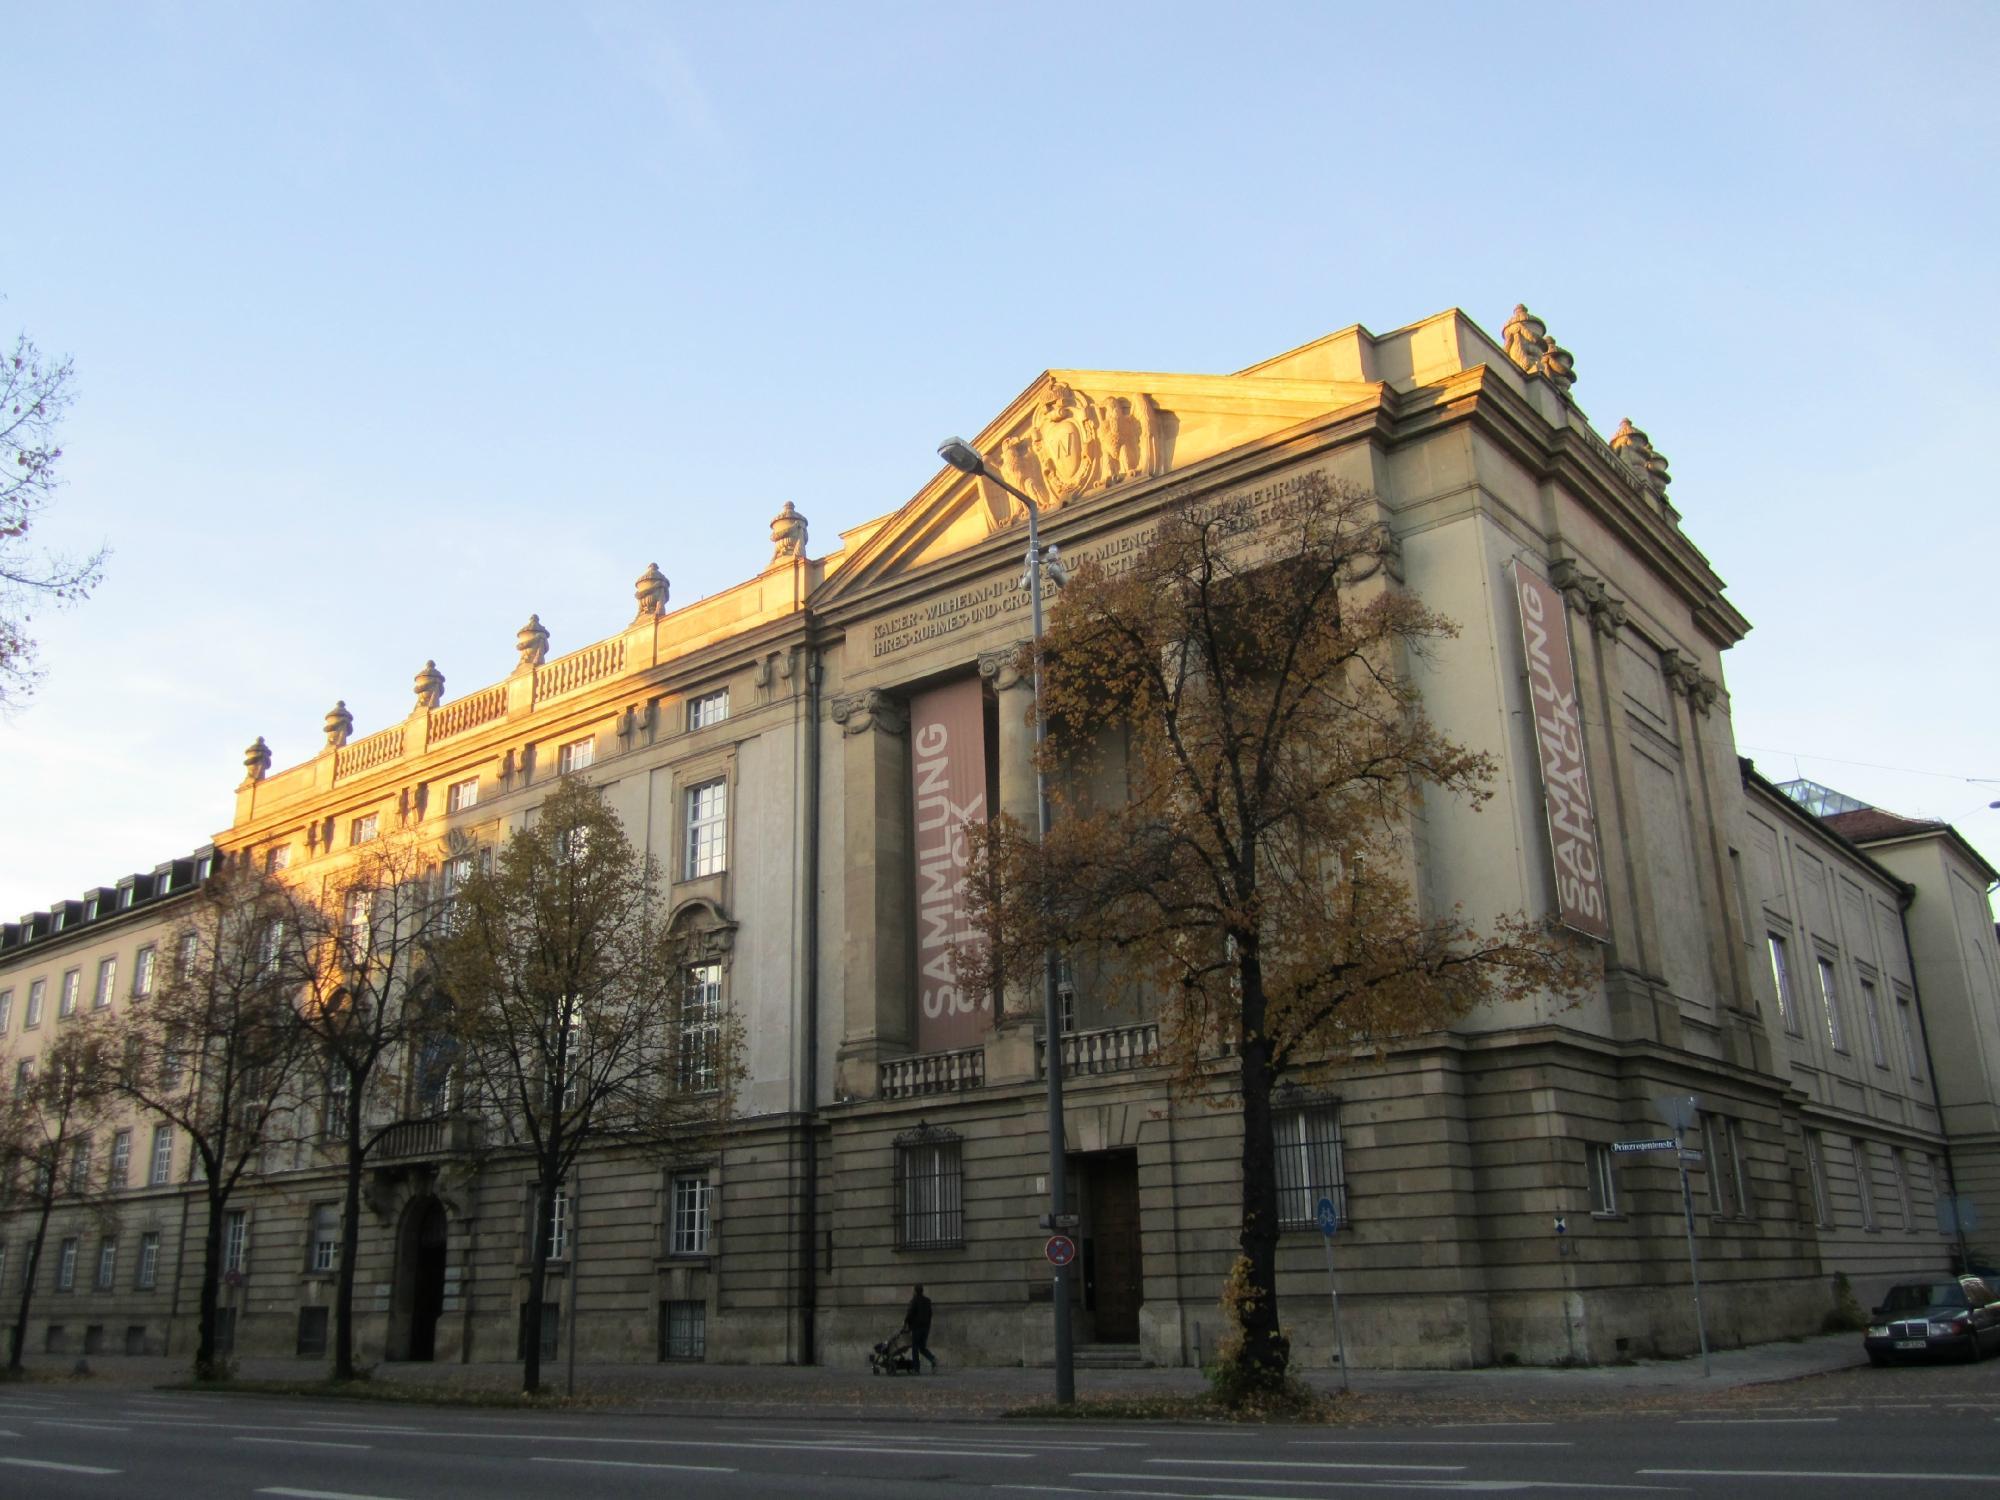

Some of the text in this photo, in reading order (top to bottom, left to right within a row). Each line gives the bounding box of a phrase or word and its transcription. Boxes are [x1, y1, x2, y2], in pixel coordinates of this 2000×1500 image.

[872, 612, 916, 639] KAISER
[925, 586, 987, 621] WILHELM
[1040, 551, 1088, 580] SADT
[1096, 522, 1171, 561] MUENCH
[873, 632, 908, 657] IHRES
[912, 612, 967, 643] RUHMES
[970, 601, 998, 624] UND
[1523, 583, 1583, 910] SAMMLUNG
[1557, 692, 1600, 918] SCHACK
[915, 722, 955, 1018] SAMMLUNG
